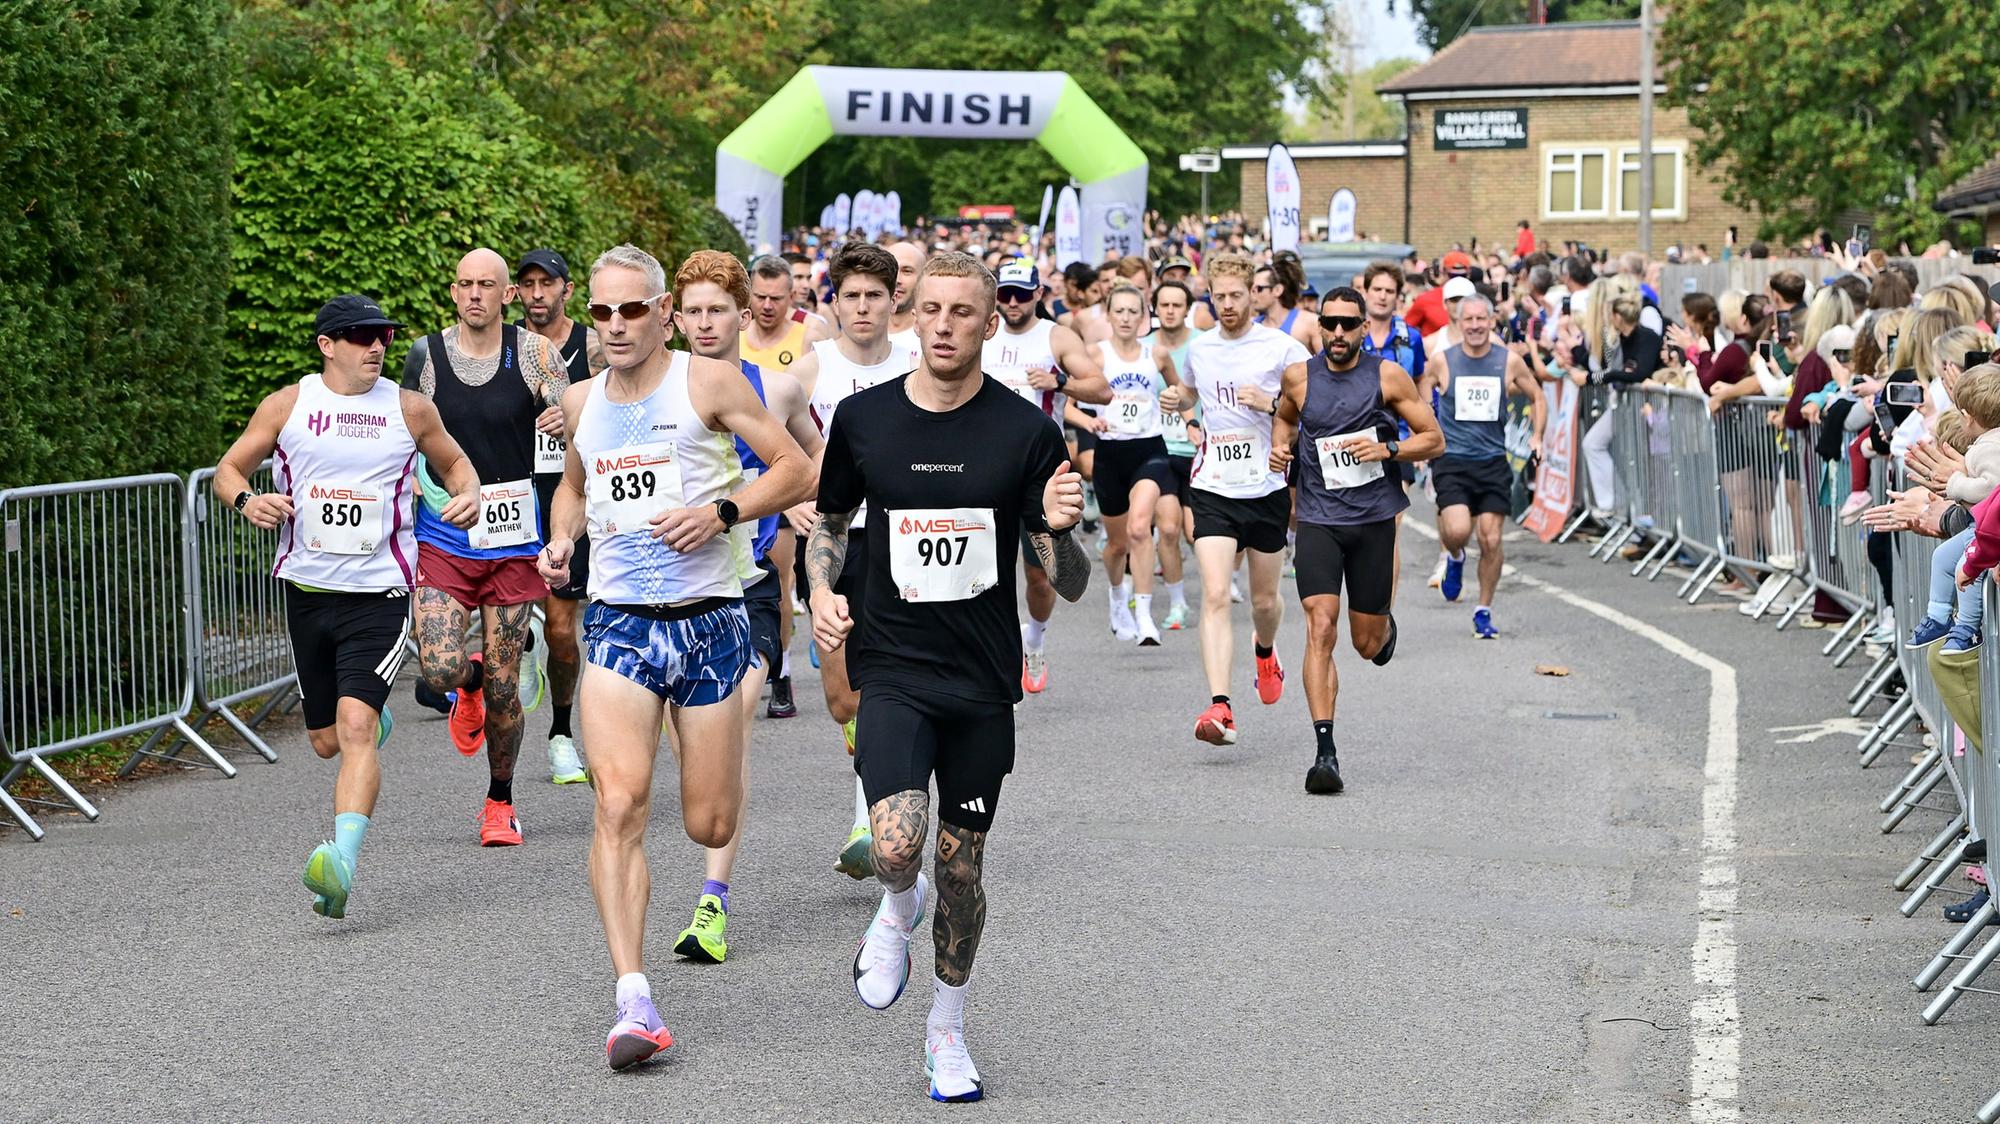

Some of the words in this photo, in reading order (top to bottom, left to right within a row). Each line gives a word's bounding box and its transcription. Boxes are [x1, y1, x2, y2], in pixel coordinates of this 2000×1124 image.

[847, 90, 1031, 126] FINISH
[1481, 111, 1518, 124] GREEN
[1436, 124, 1489, 140] VILLAGE
[1491, 122, 1526, 139] HALL
[504, 346, 513, 369] soar
[1001, 345, 1020, 366] hj
[1110, 372, 1151, 390] PHOENIX
[1216, 380, 1236, 408] hj
[1467, 388, 1489, 401] 280
[1122, 403, 1138, 417] 20
[336, 413, 387, 427] HORSHAM
[336, 425, 381, 440] JOGGERS
[542, 453, 563, 461] JAMES
[1217, 443, 1252, 462] 1082
[605, 454, 671, 472] MSL
[911, 463, 965, 473] onepercent
[320, 488, 377, 501] MSL
[611, 470, 656, 502] 839
[481, 489, 529, 502] MSL
[321, 502, 363, 528] 850
[486, 500, 520, 525] 605
[487, 522, 523, 535] MATTHEW
[914, 519, 986, 533] MSL
[917, 536, 969, 567] 907
